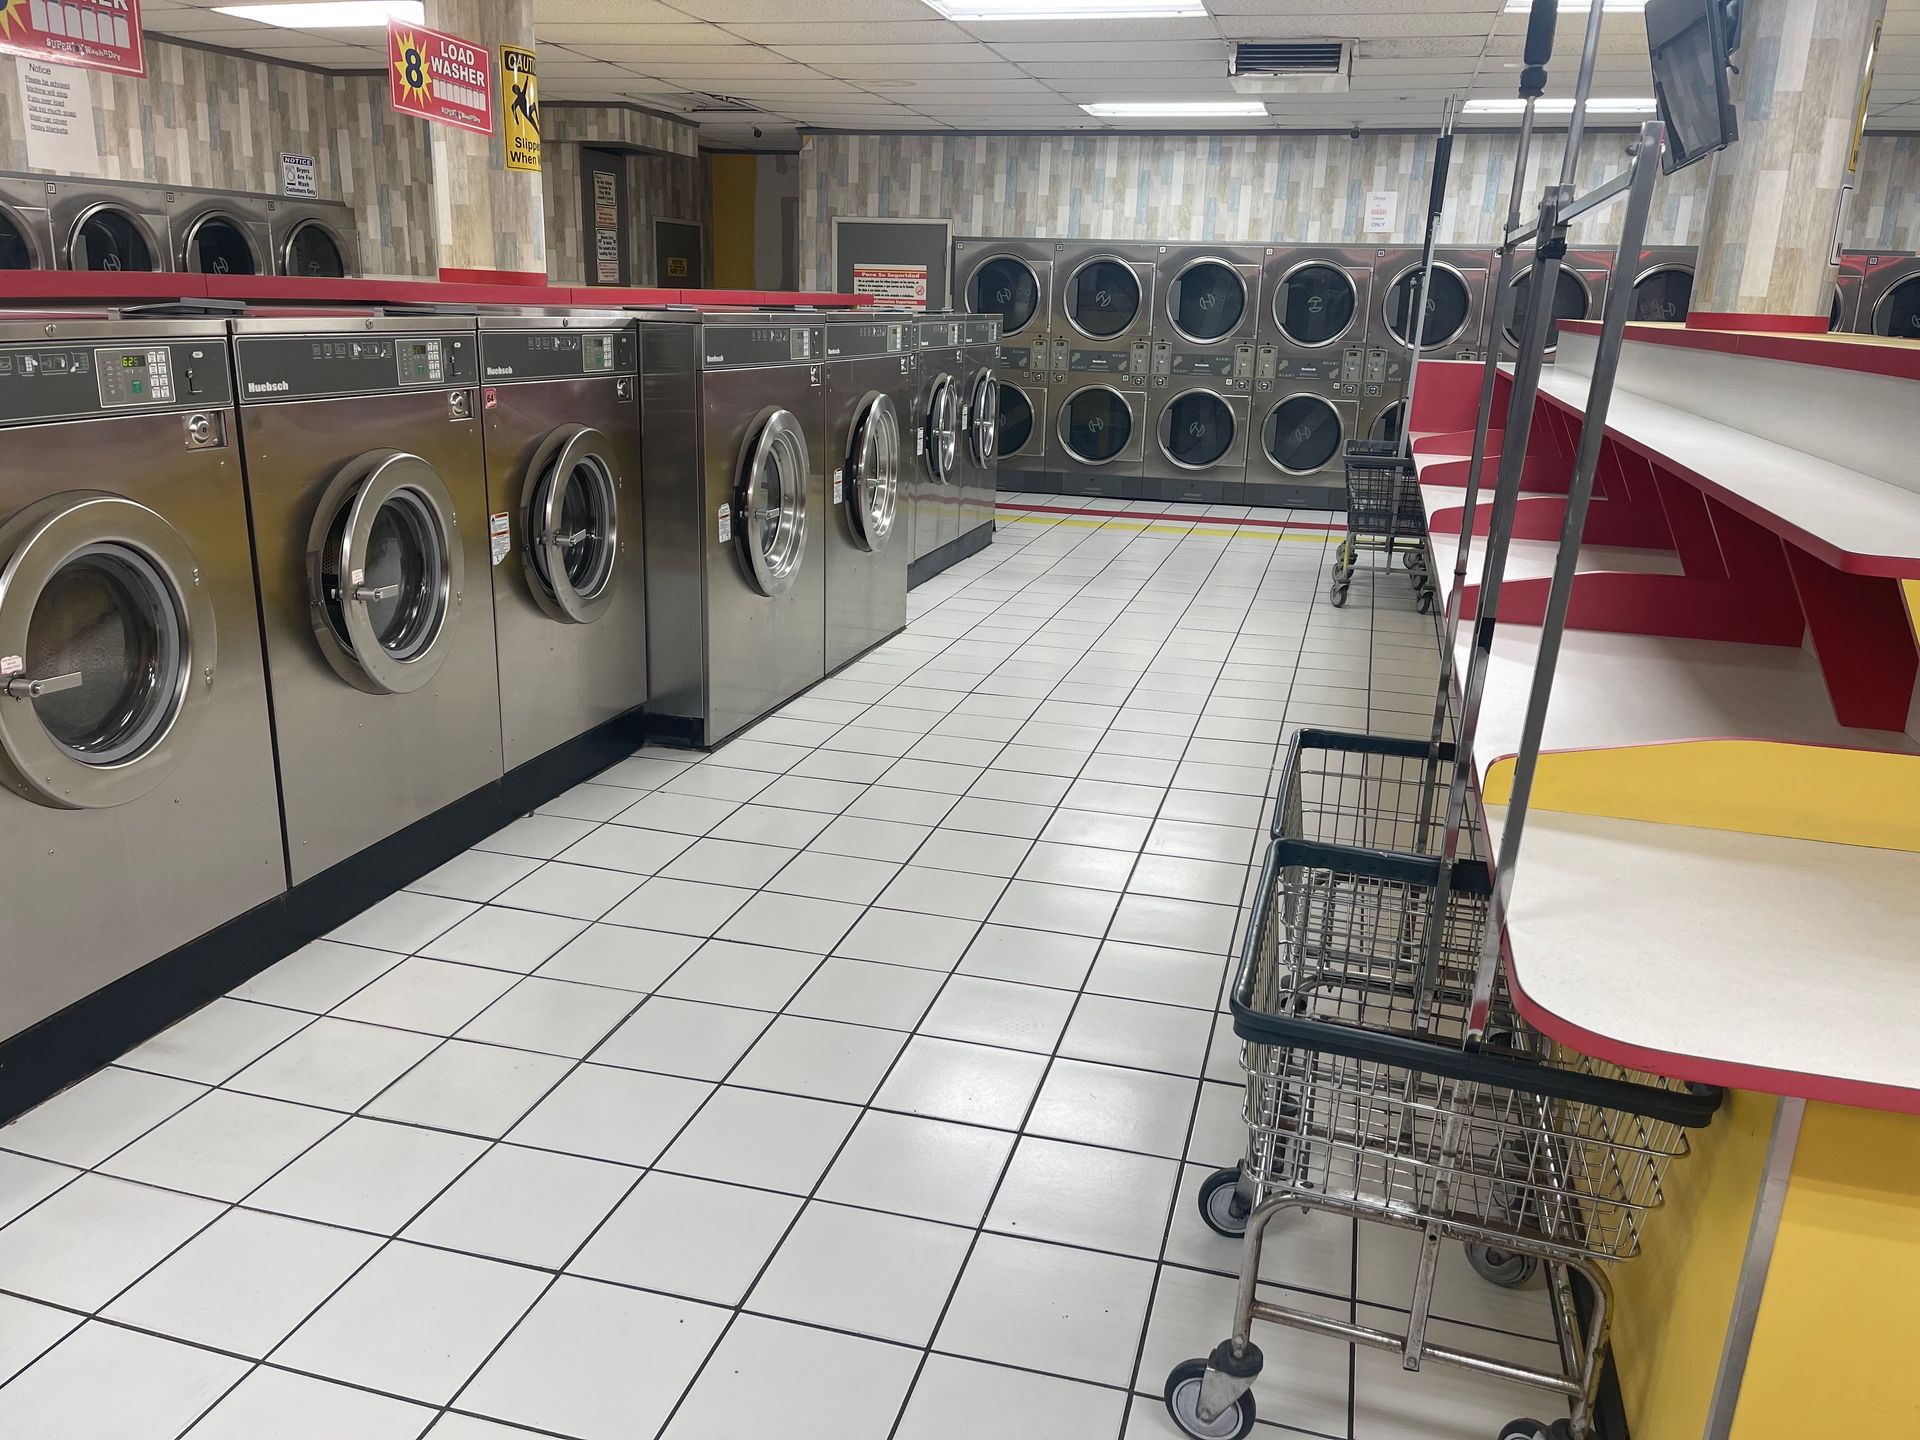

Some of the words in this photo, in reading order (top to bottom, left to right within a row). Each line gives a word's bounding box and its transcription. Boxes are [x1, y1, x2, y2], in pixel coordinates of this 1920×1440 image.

[46, 38, 73, 51] SUPER
[440, 41, 475, 66] LOAD
[29, 63, 51, 75] Notice
[405, 48, 423, 88] 8
[431, 56, 486, 87] WASHER
[25, 75, 41, 85] Please
[42, 79, 49, 87] be
[50, 81, 70, 89] advised
[26, 84, 47, 94] Machine
[53, 99, 65, 107] load
[285, 157, 312, 165] NOTICE
[510, 151, 537, 165] When
[486, 366, 513, 375] Huebsch
[248, 381, 289, 393] Huebsch
[487, 394, 494, 402] 64
